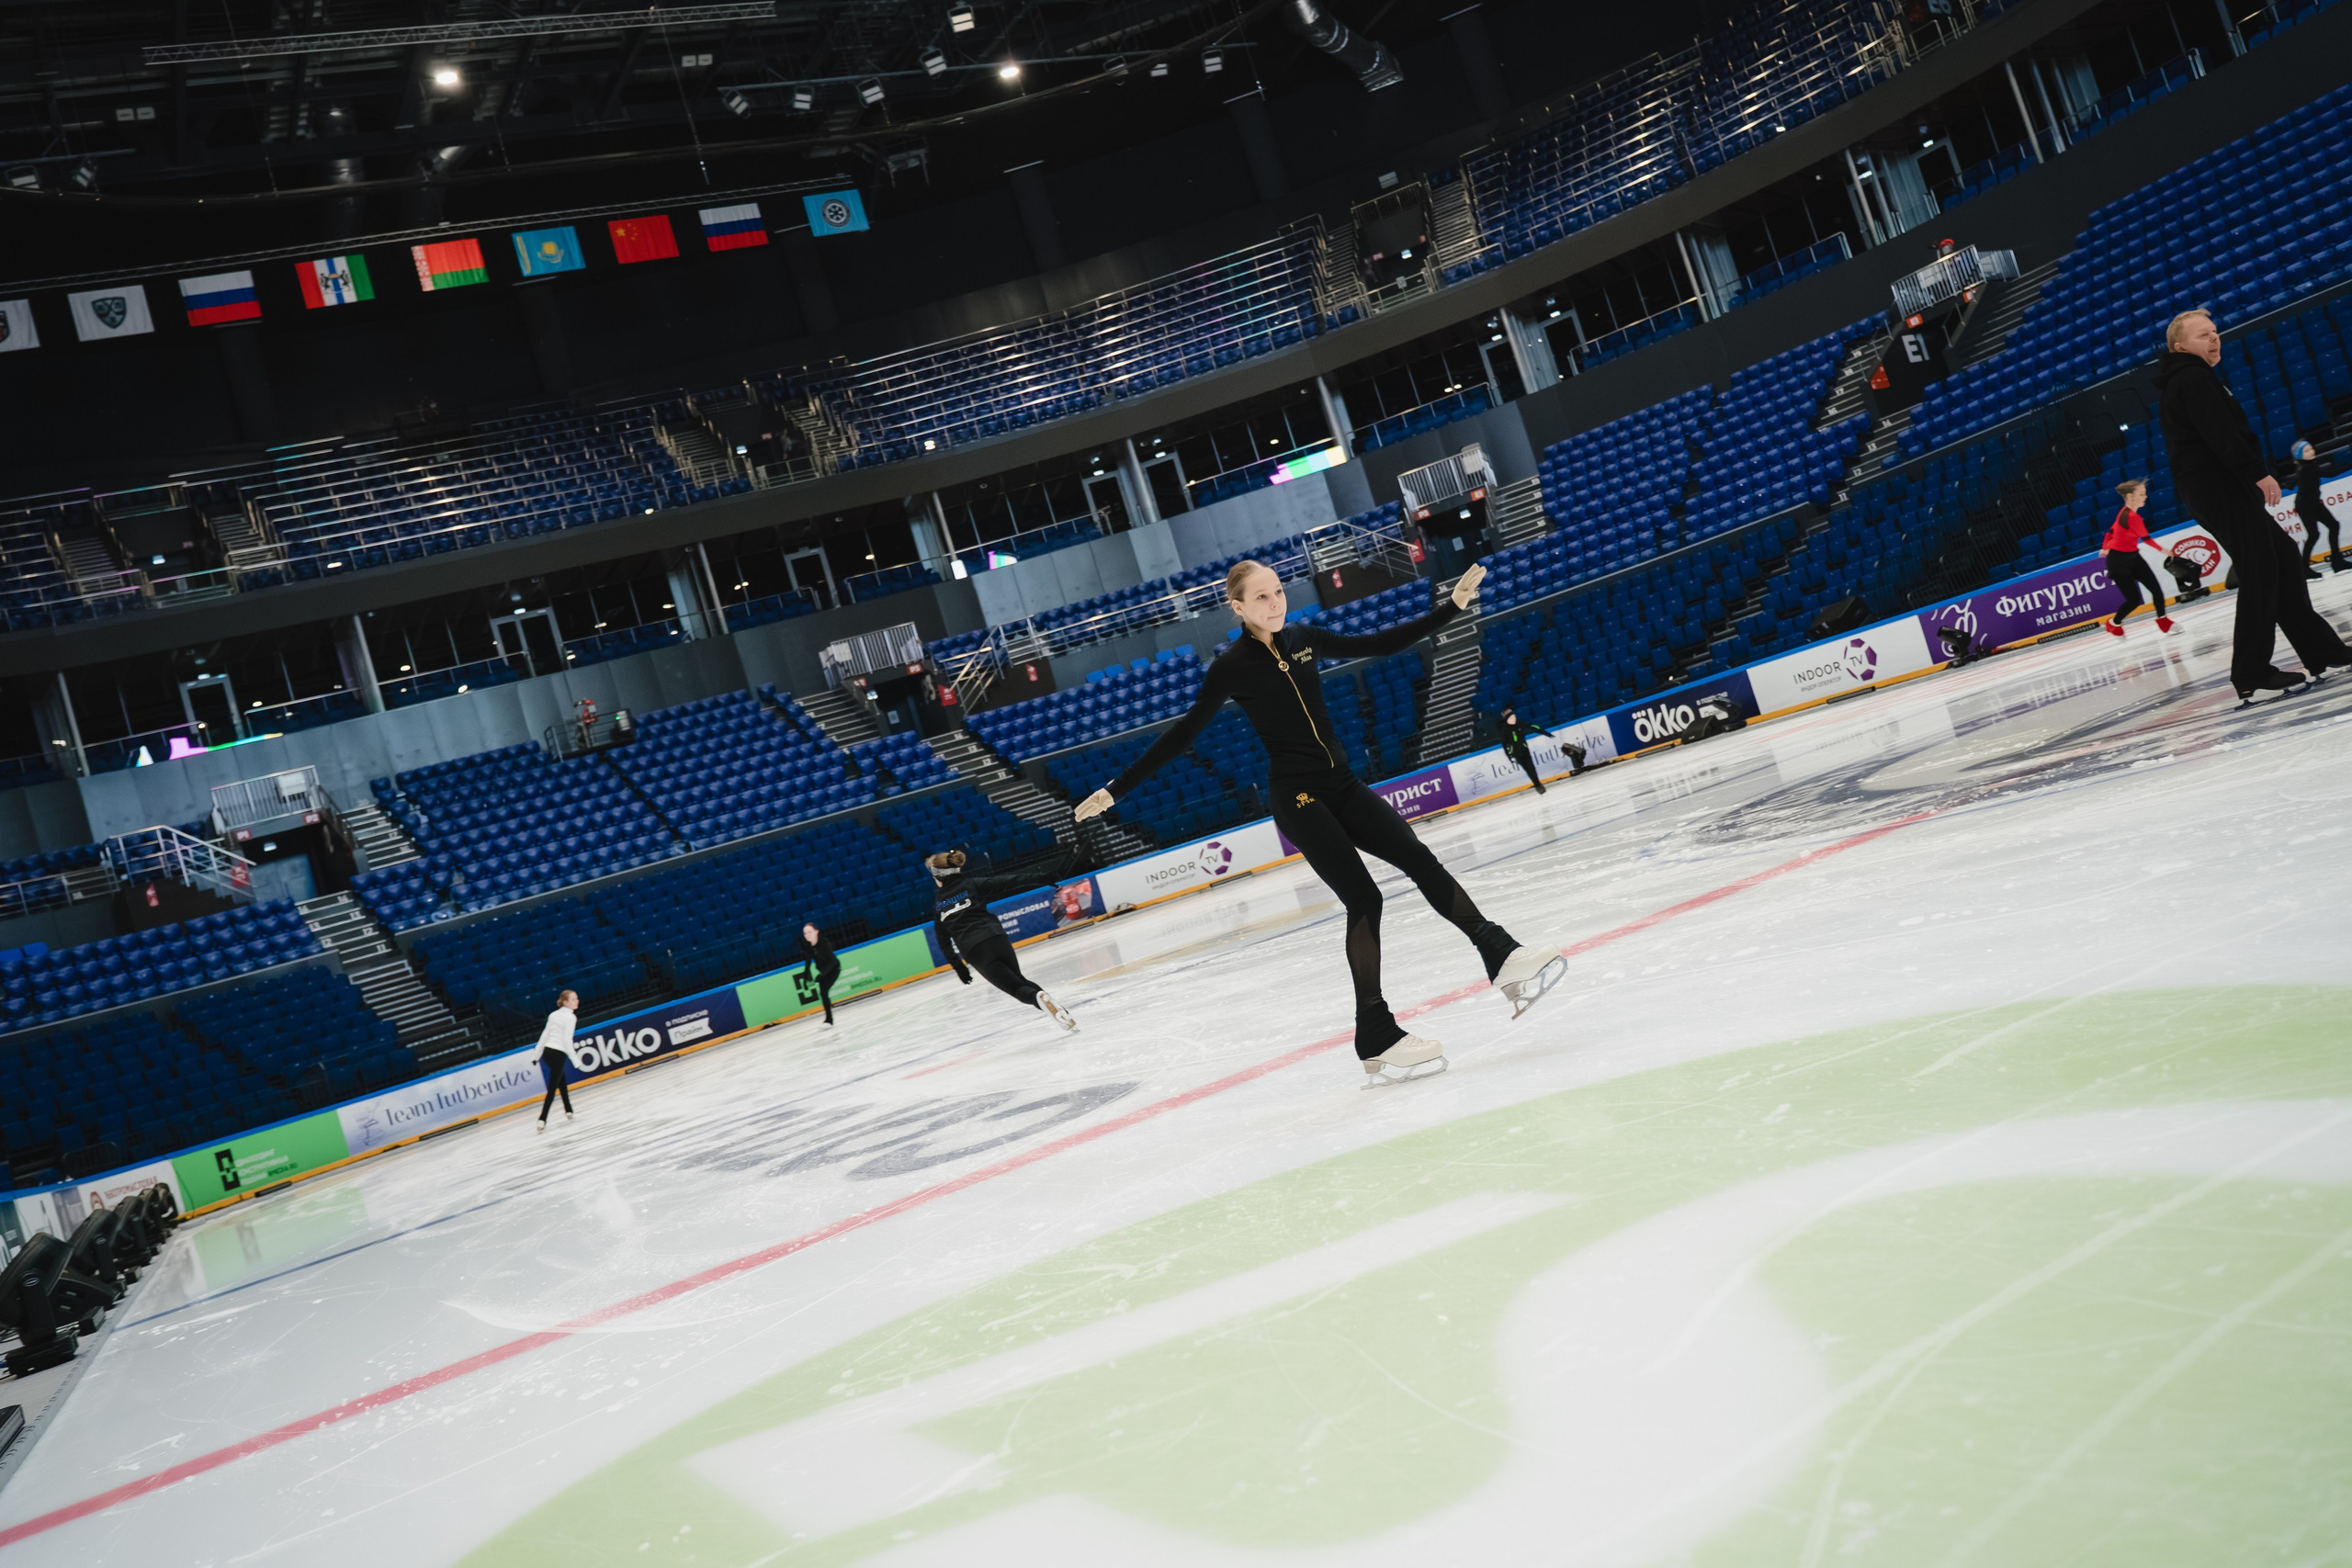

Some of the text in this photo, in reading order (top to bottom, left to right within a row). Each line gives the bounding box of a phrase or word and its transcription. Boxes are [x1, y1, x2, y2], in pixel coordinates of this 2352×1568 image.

[1901, 333, 1930, 363] E1
[2035, 603, 2092, 626] магазин
[1792, 654, 1863, 684] INDOOR TV
[1381, 778, 1442, 807] урист
[1145, 854, 1219, 885] INDOOR TV
